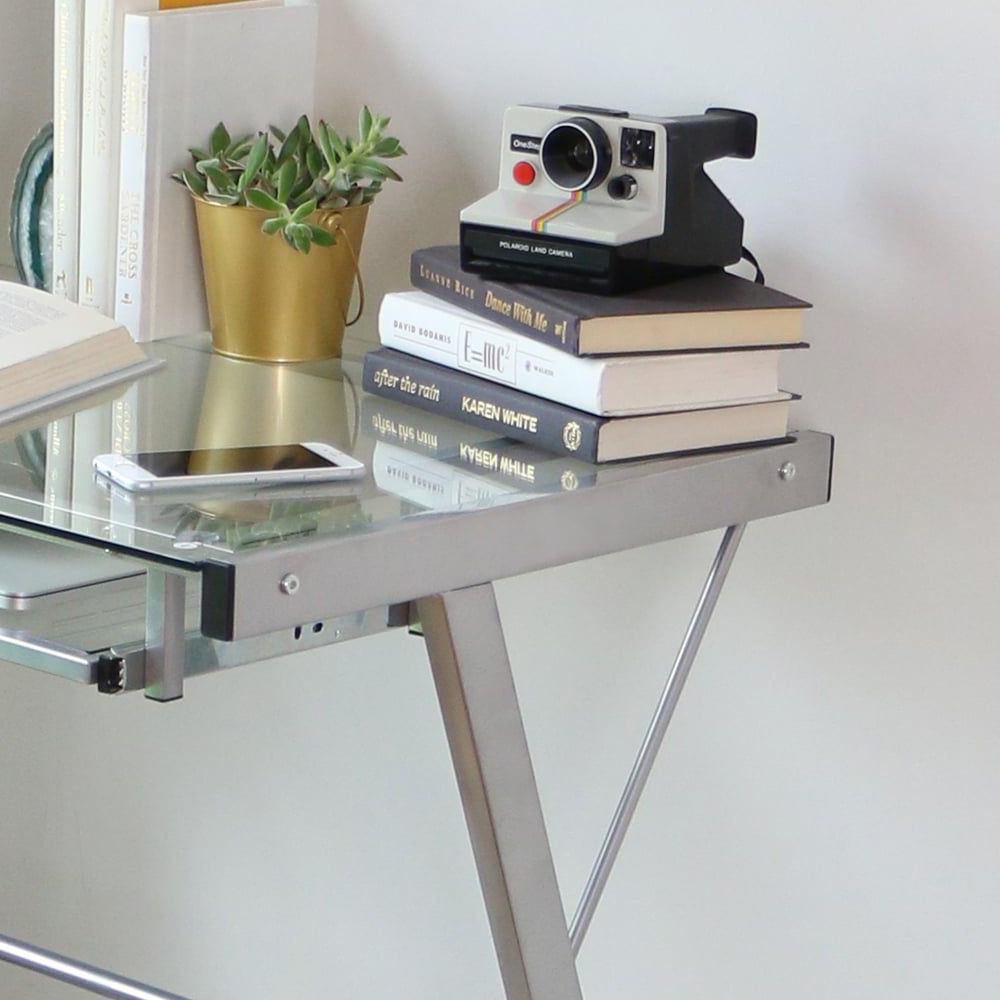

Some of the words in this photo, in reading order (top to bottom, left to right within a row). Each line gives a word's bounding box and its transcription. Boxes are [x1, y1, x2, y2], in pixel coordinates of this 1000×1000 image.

[128, 230, 138, 279] CROSS
[499, 241, 530, 252] POLAROID
[530, 245, 548, 255] LAND
[548, 248, 574, 258] CAMERA
[393, 319, 416, 334] DAVID
[485, 290, 511, 316] Dance
[513, 302, 532, 327] With
[533, 311, 547, 333] Me
[373, 368, 399, 388] after
[400, 375, 417, 394] the
[418, 384, 440, 402] rain
[461, 396, 501, 422] KAREN
[502, 408, 538, 433] WHITE
